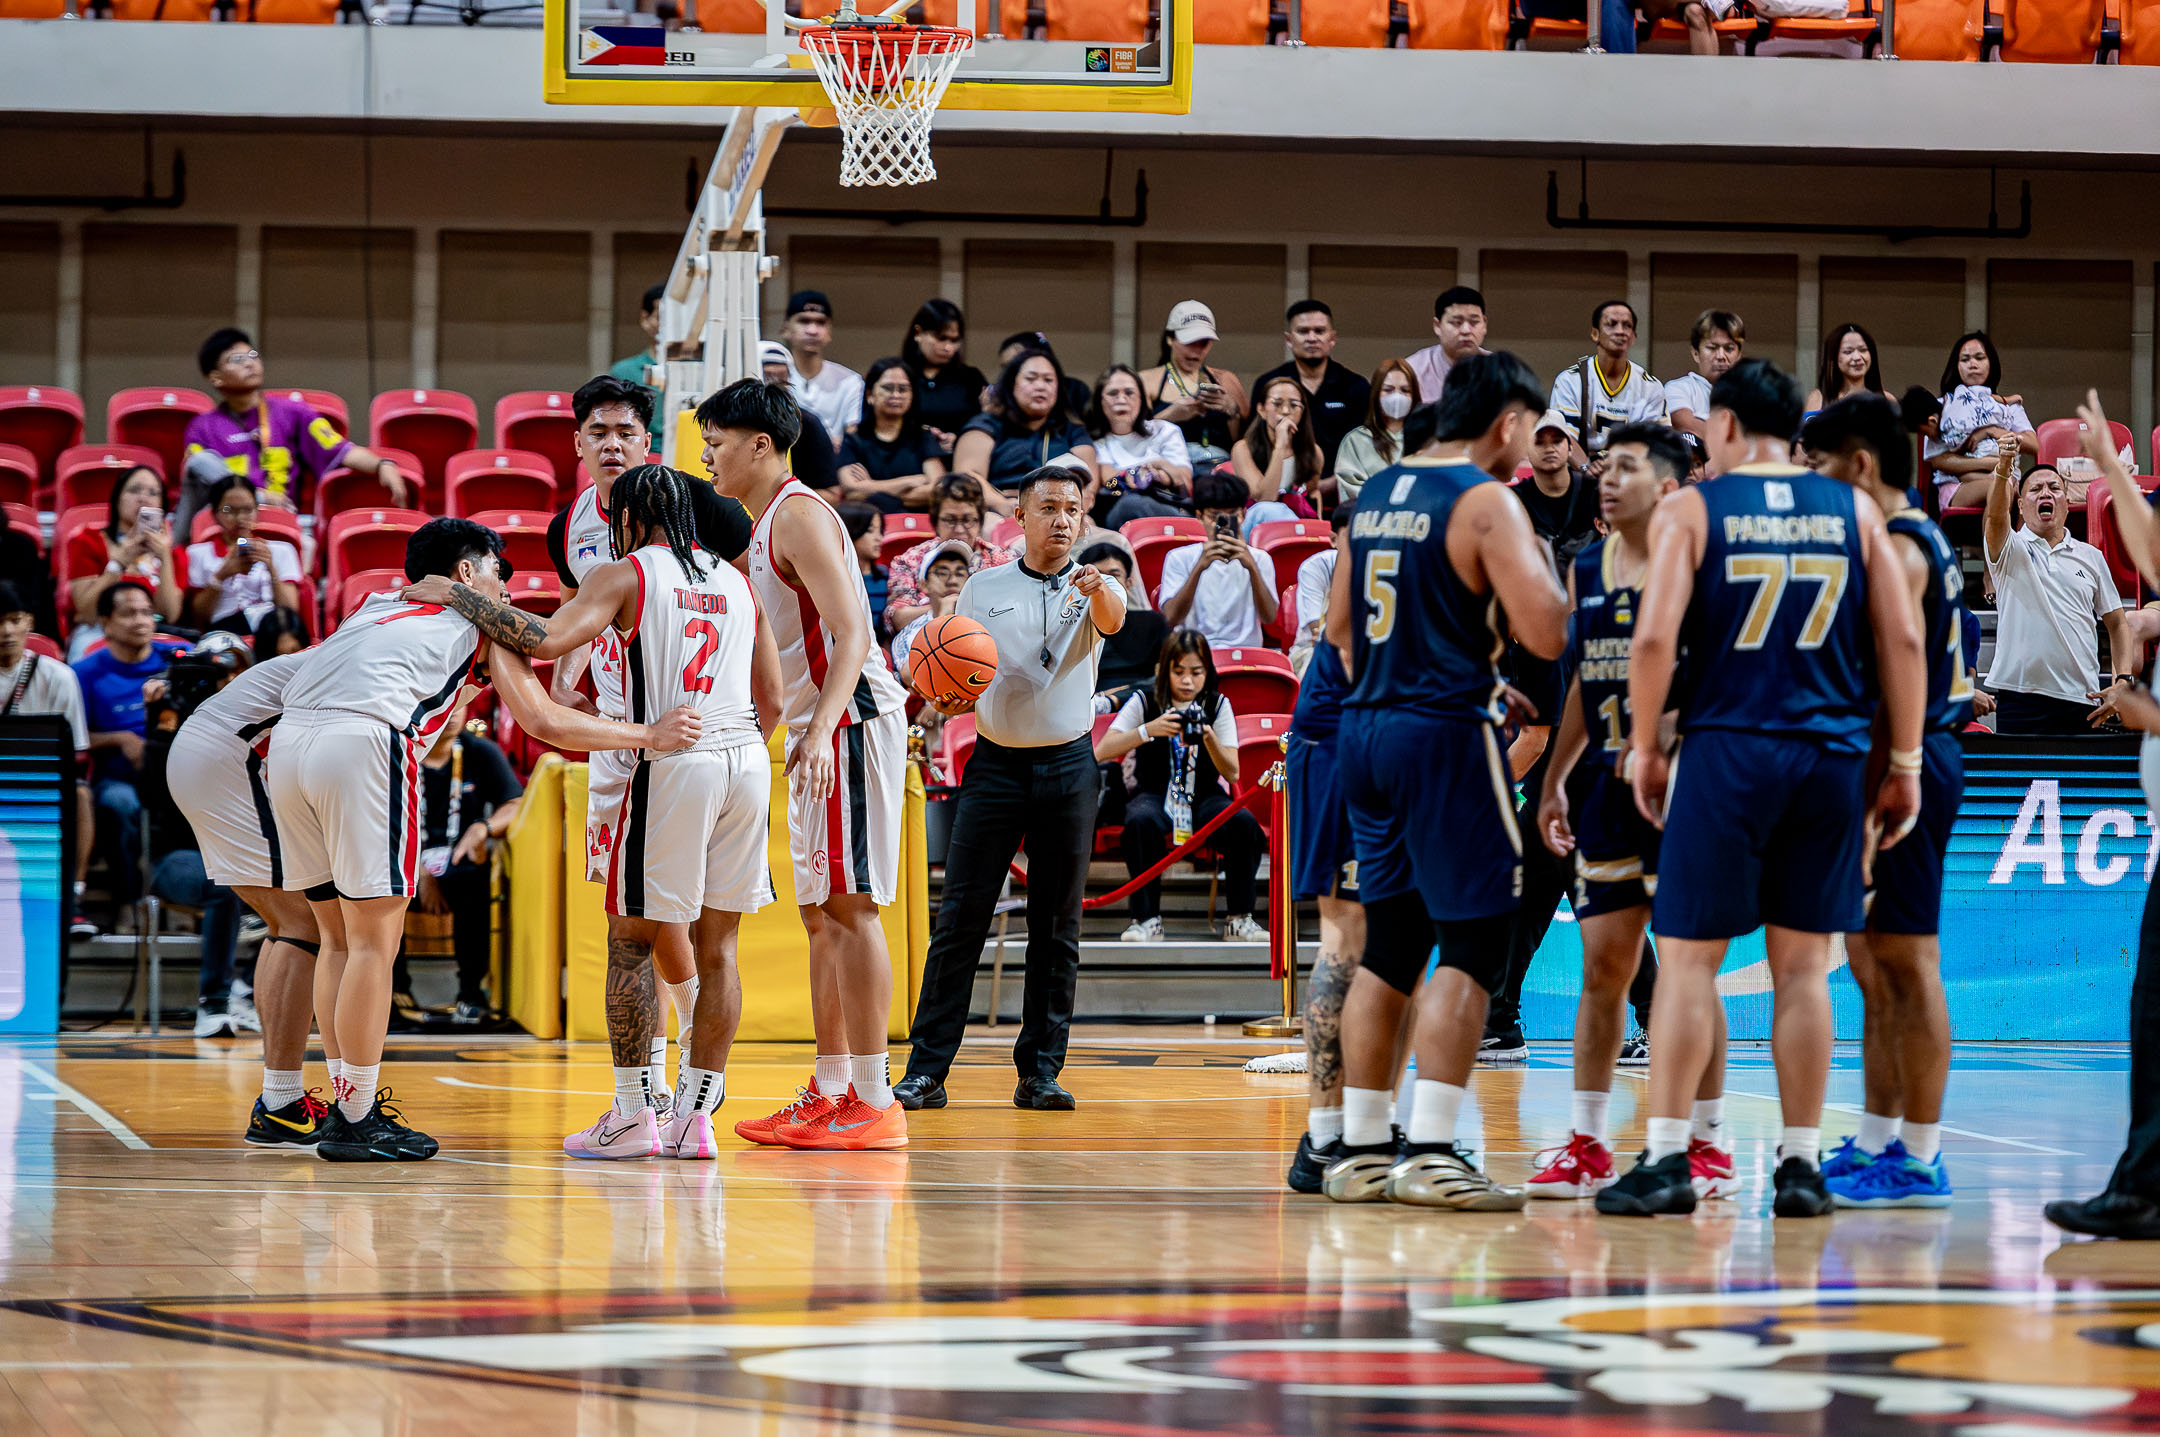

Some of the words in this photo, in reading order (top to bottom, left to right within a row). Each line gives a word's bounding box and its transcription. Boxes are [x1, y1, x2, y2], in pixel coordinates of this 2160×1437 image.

[1115, 50, 1133, 60] FIBA
[1723, 514, 1846, 546] PADRONES
[1363, 550, 1401, 645] 5
[1725, 552, 1850, 650] 77
[682, 617, 720, 694] 2
[588, 822, 613, 857] 24
[1341, 860, 1361, 890] 1
